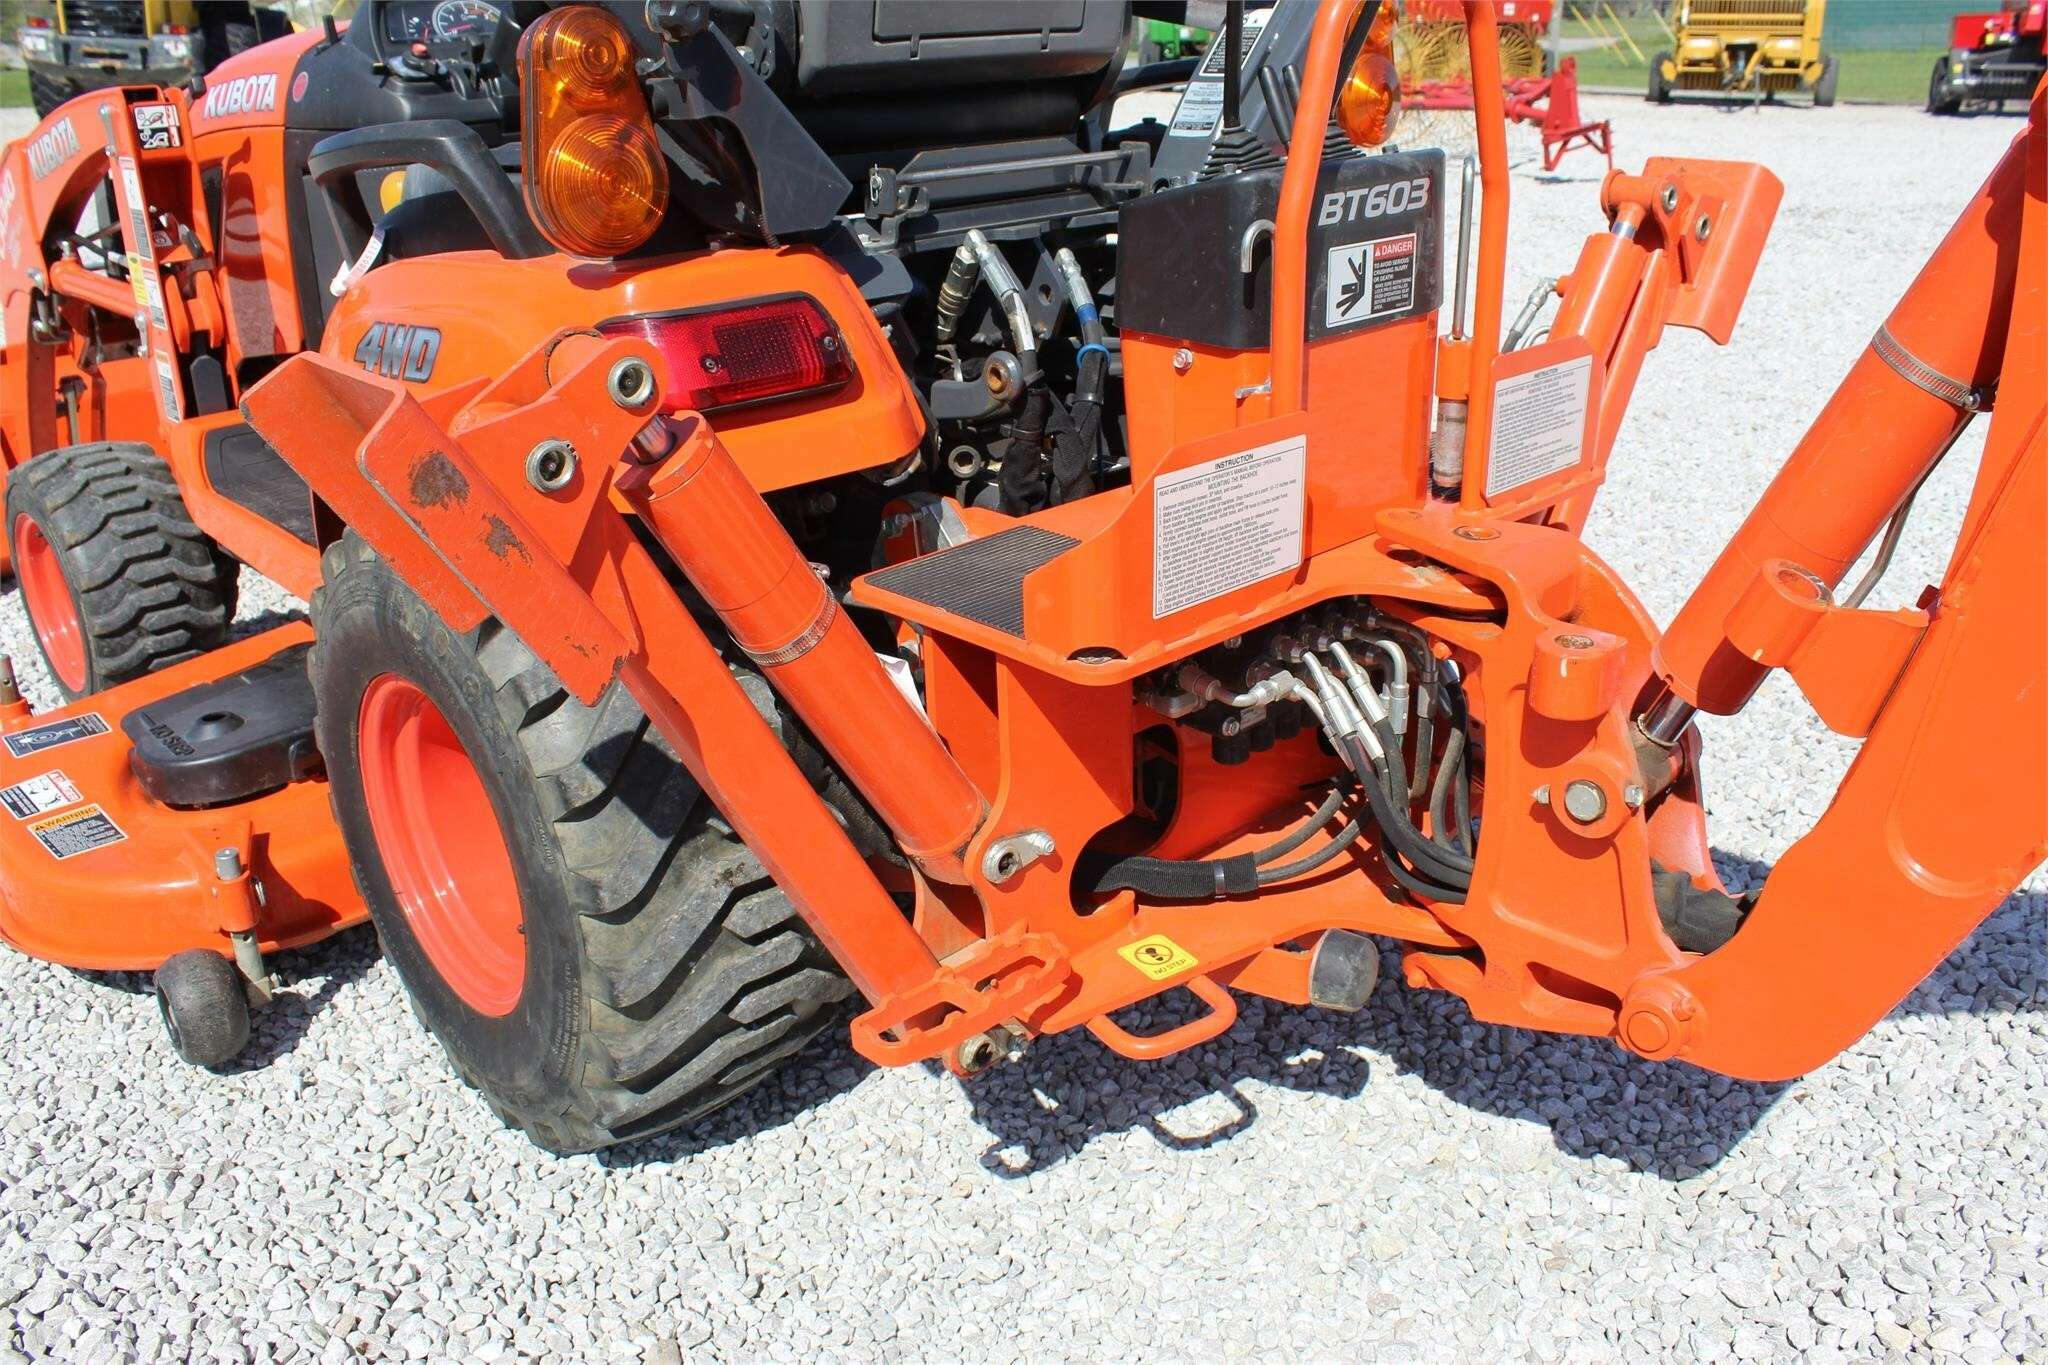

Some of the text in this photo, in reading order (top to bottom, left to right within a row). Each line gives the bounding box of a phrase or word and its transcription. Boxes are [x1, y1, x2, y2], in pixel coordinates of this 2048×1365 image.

[203, 73, 279, 120] KUBOTA
[27, 115, 80, 181] KUBOTA
[1318, 177, 1430, 226] BT603
[1381, 240, 1412, 255] DANGER
[1380, 273, 1393, 281] DEATH
[353, 320, 442, 384] 4WD
[1215, 454, 1253, 470] INSTRUCTION
[1179, 480, 1203, 490] UNDERSTAND
[1208, 479, 1230, 490] MOUNTING
[1240, 470, 1258, 480] BACKHOE
[44, 806, 98, 826] WARNING
